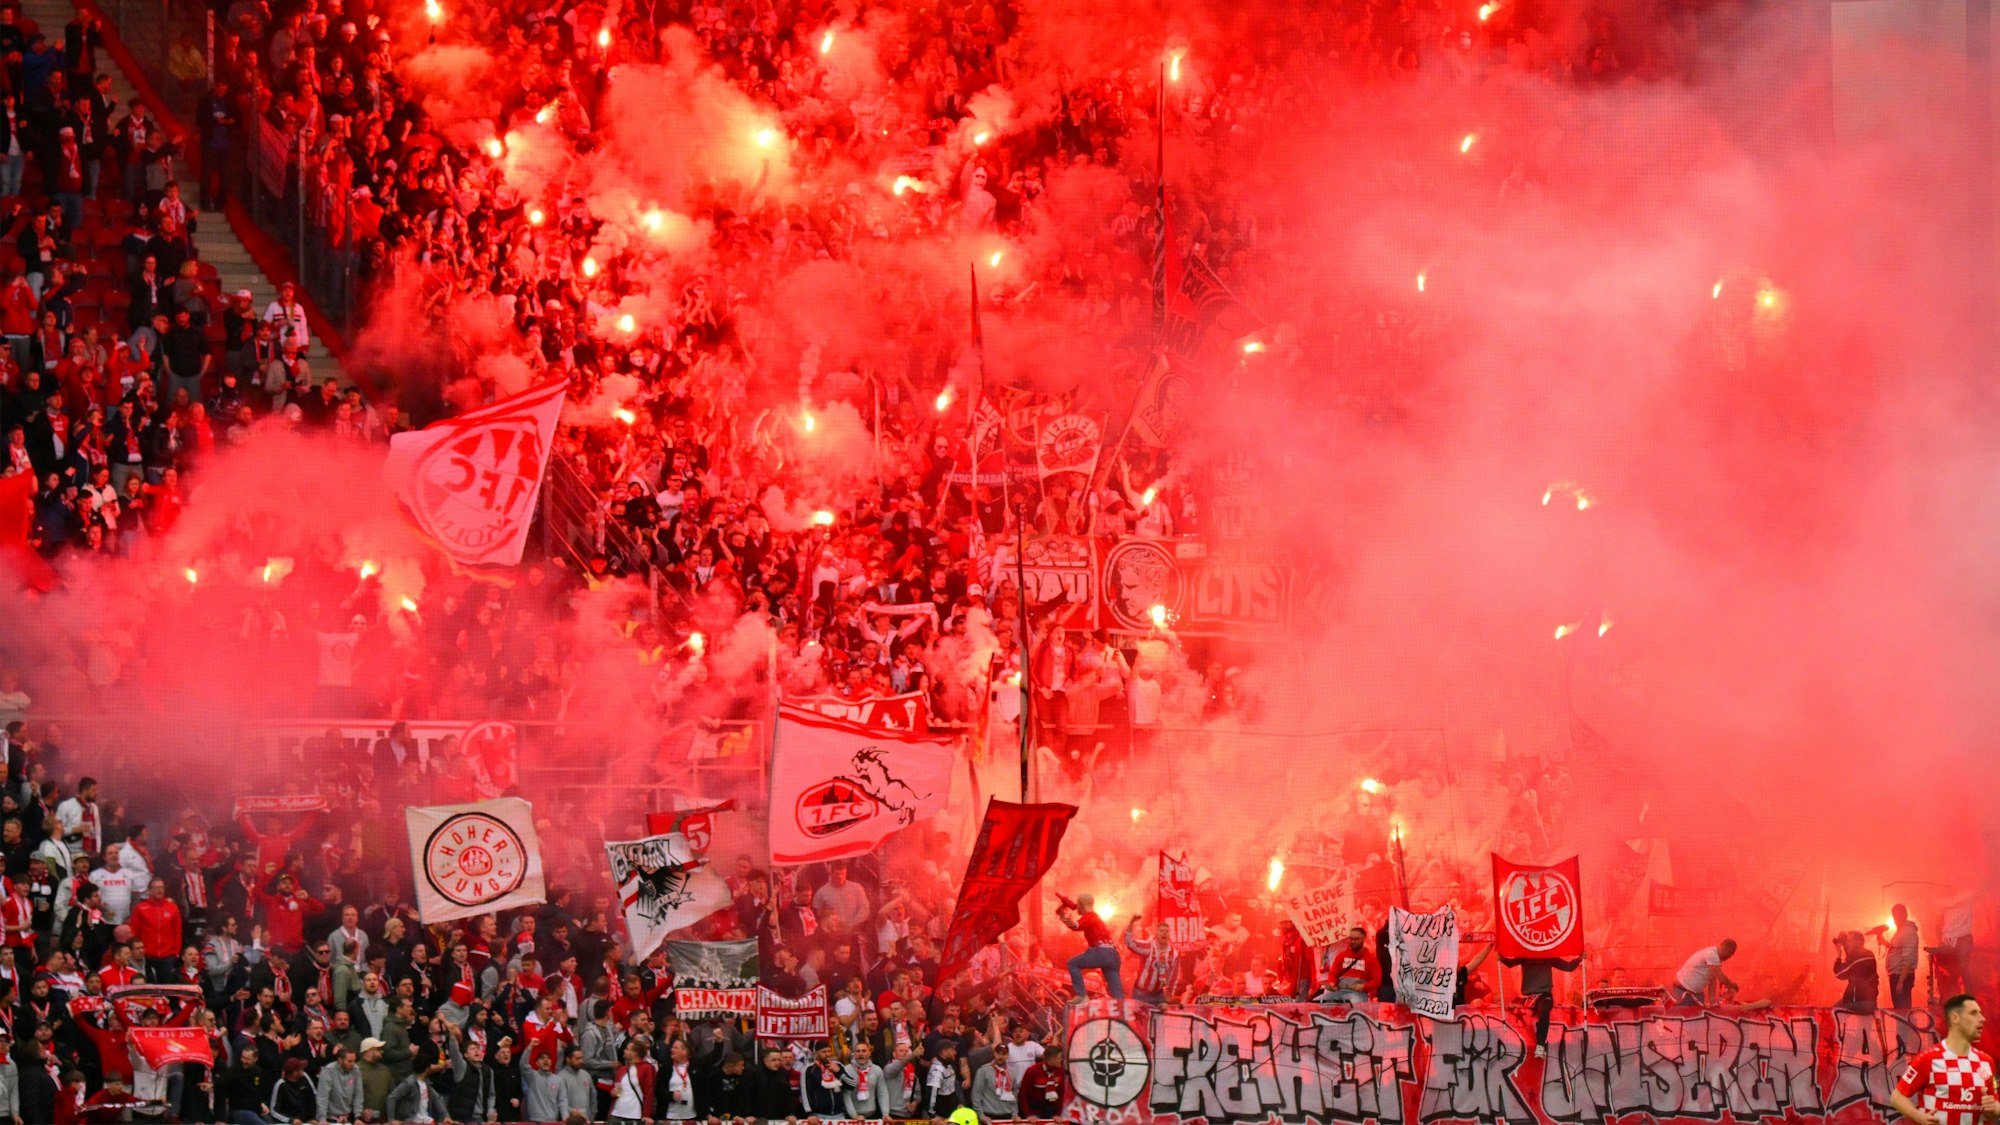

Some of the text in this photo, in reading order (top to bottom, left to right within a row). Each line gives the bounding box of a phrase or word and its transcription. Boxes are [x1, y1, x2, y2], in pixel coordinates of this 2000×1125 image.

[810, 801, 865, 825] 1.FC
[441, 869, 513, 897] JUNGS
[1304, 902, 1338, 921] LANG
[1517, 887, 1559, 924] 1.FC
[1519, 923, 1563, 943] KÖLN
[1417, 941, 1438, 963] LA
[678, 990, 757, 1010] CHAOTIX
[1074, 999, 1136, 1024] FREE
[1417, 998, 1449, 1015] ARDA
[1066, 1096, 1142, 1125] ARDA
